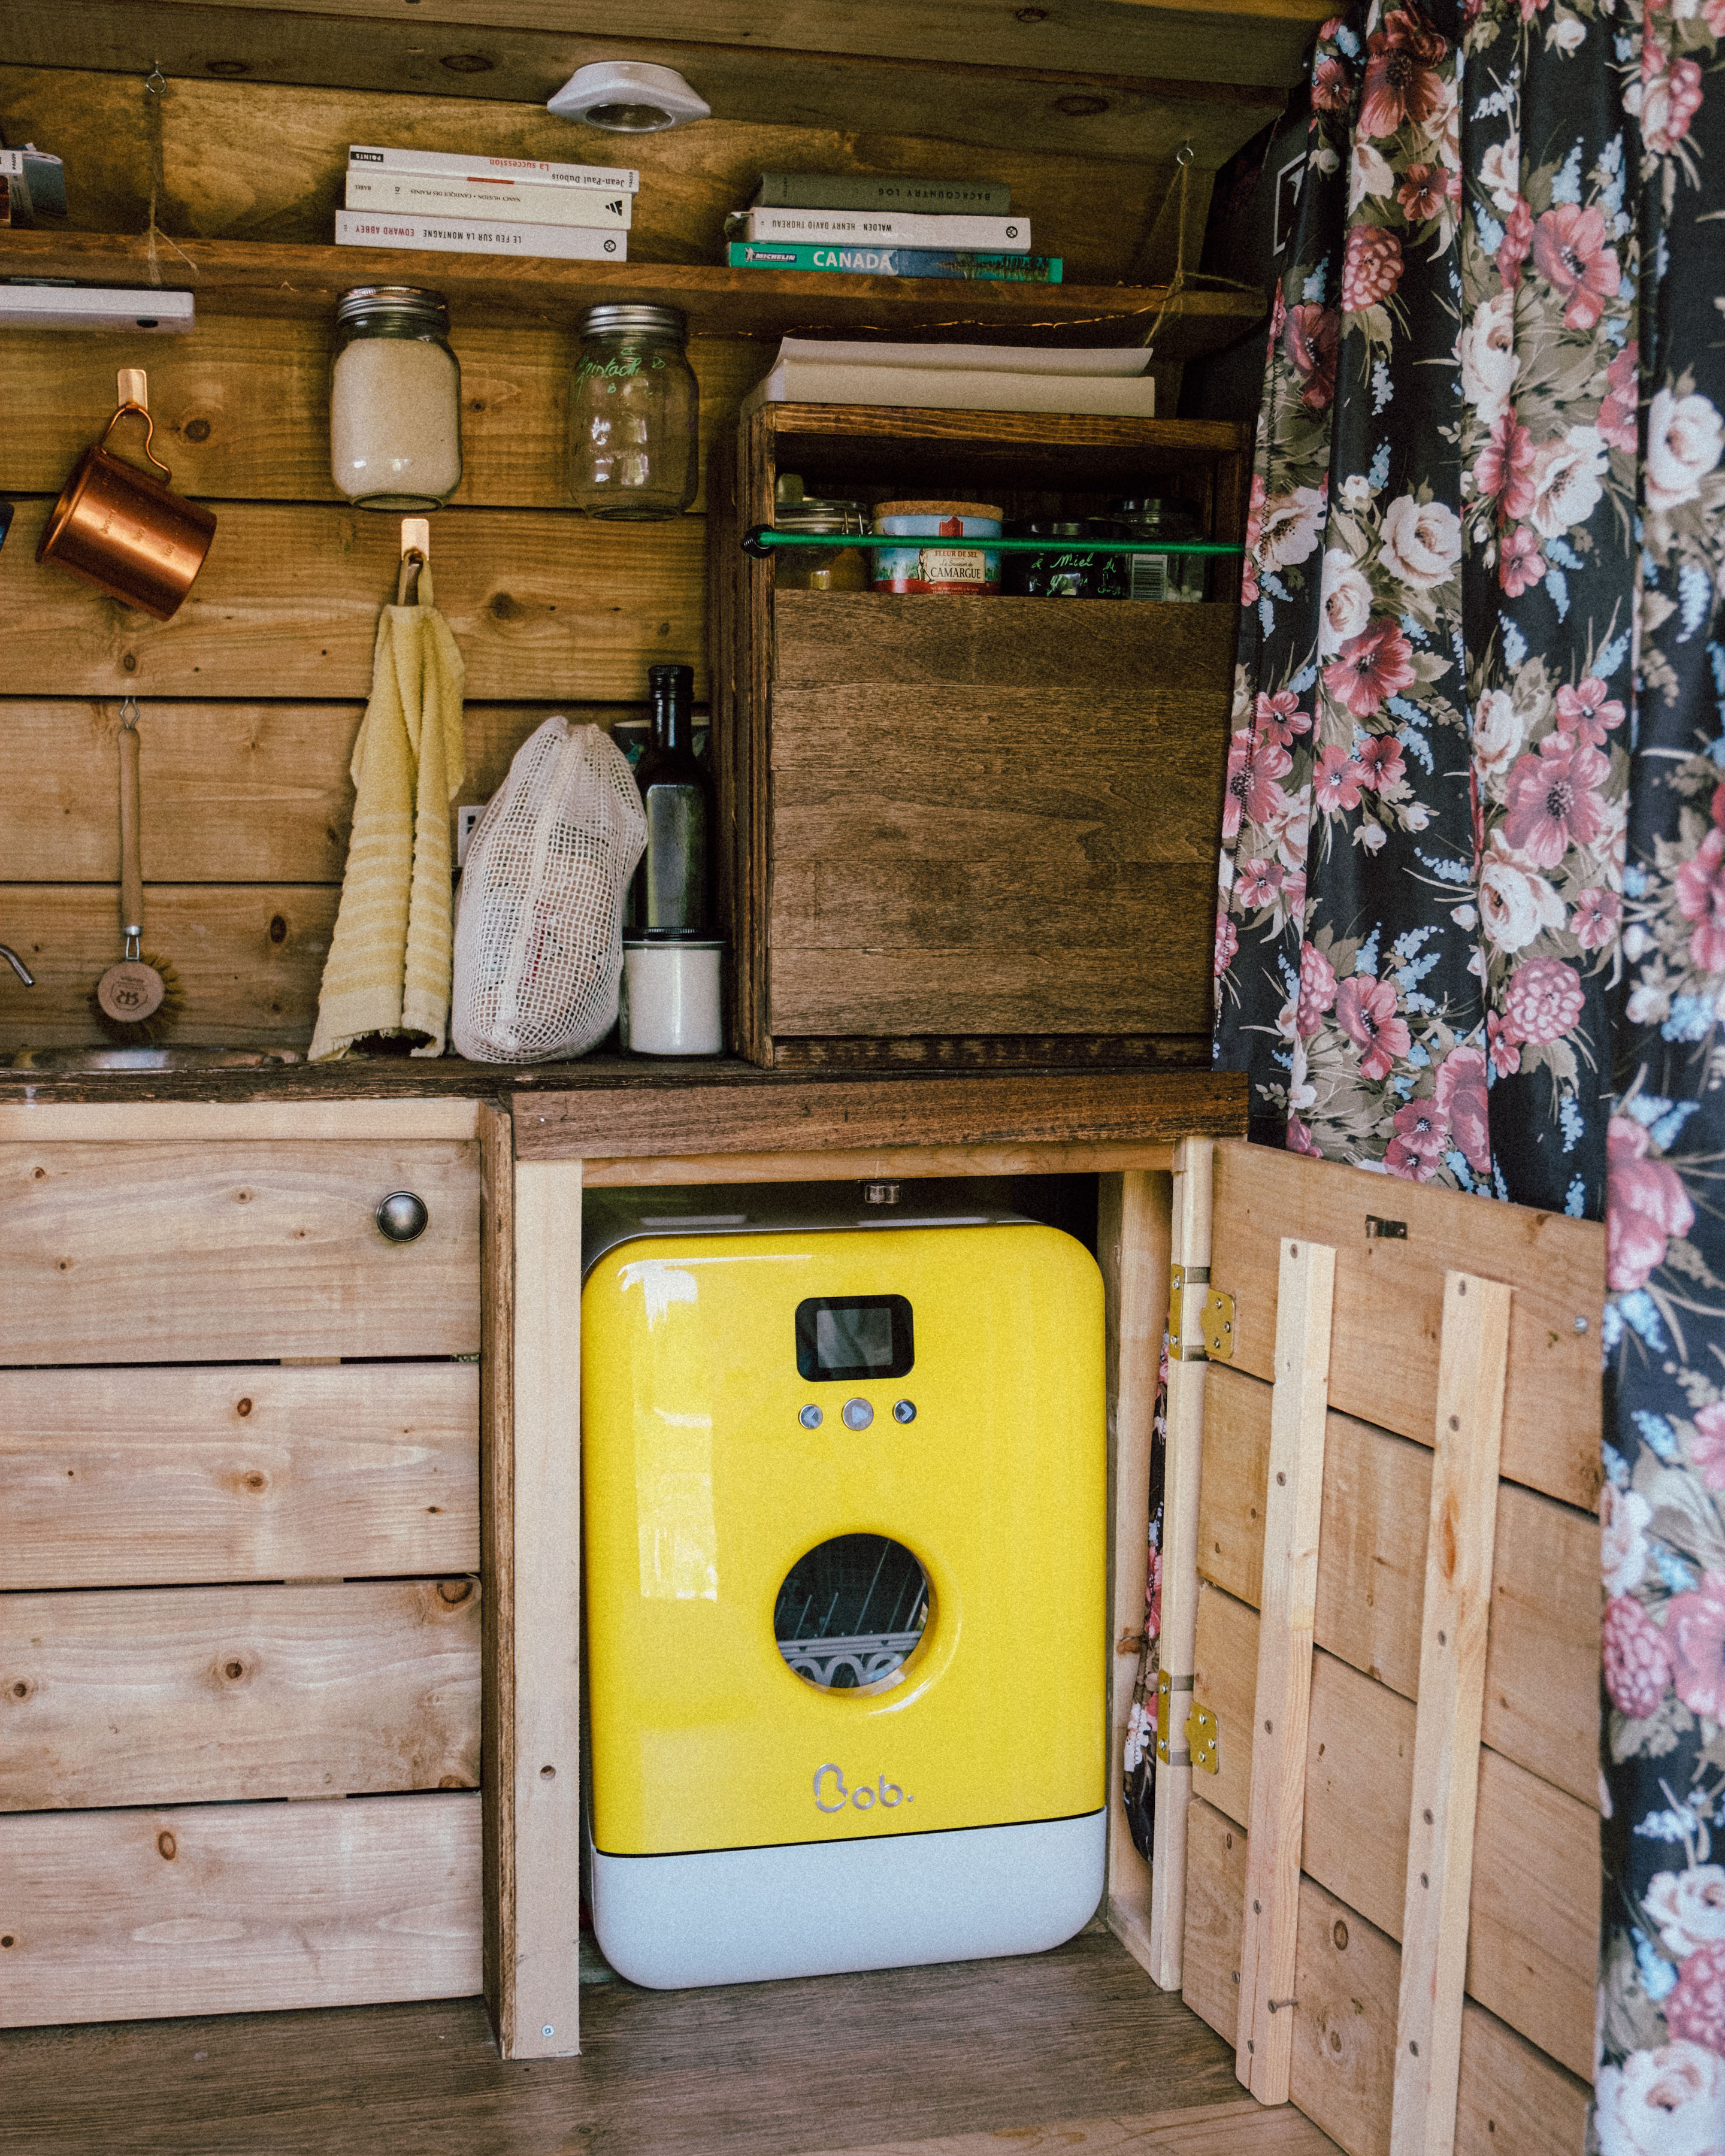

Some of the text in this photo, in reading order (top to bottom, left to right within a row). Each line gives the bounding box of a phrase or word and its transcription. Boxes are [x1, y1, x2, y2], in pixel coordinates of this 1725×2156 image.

[489, 159, 550, 172] La succession
[552, 173, 625, 187] Jean-Paul Dubois
[444, 191, 472, 199] CANTIQUE
[878, 187, 991, 201] BACKCOUNTRY LOG
[771, 219, 805, 229] THOREAU
[808, 221, 829, 230] DAVID
[831, 223, 855, 231] HENRY
[862, 223, 892, 232] WALDEN
[355, 225, 415, 237] EDWARD ABBEY
[423, 229, 522, 243] LE FEU SUR LA MONTAGNE
[755, 252, 797, 261] MICHELIN
[813, 250, 893, 270] CANADA
[930, 567, 980, 579] CAMARGUE
[813, 1763, 915, 1813] Bob.
